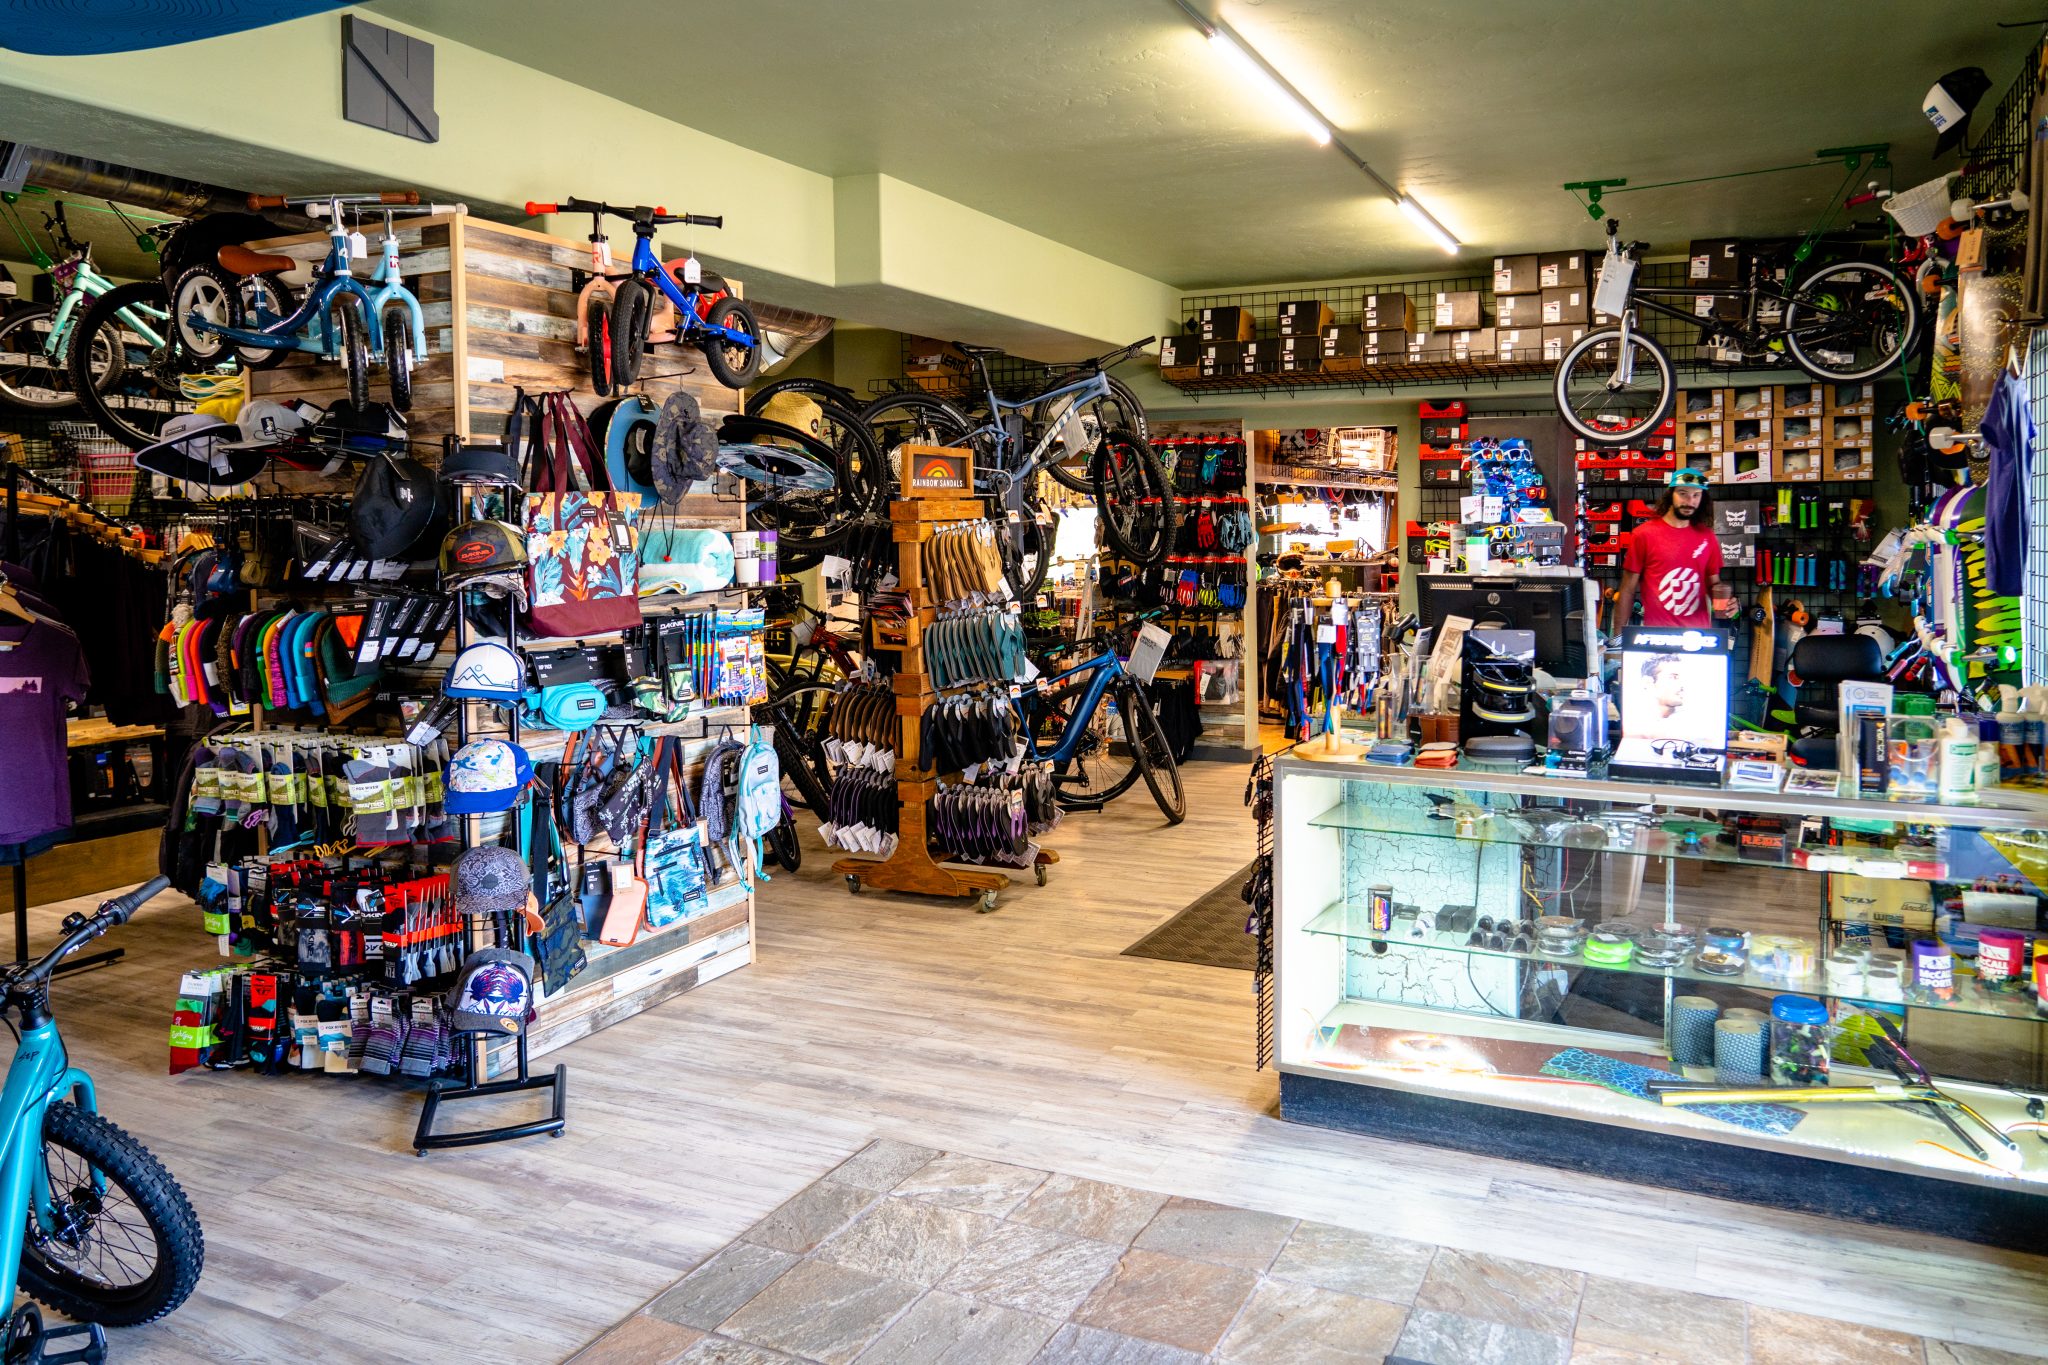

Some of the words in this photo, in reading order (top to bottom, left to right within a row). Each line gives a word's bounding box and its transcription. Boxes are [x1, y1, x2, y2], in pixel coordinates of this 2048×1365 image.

[777, 382, 815, 391] KENDA
[1138, 416, 1147, 440] MAXX
[912, 478, 938, 487] RAINBOW
[461, 550, 491, 559] DAKINE
[660, 621, 685, 630] DAKINE
[1919, 968, 1952, 980] McCALL
